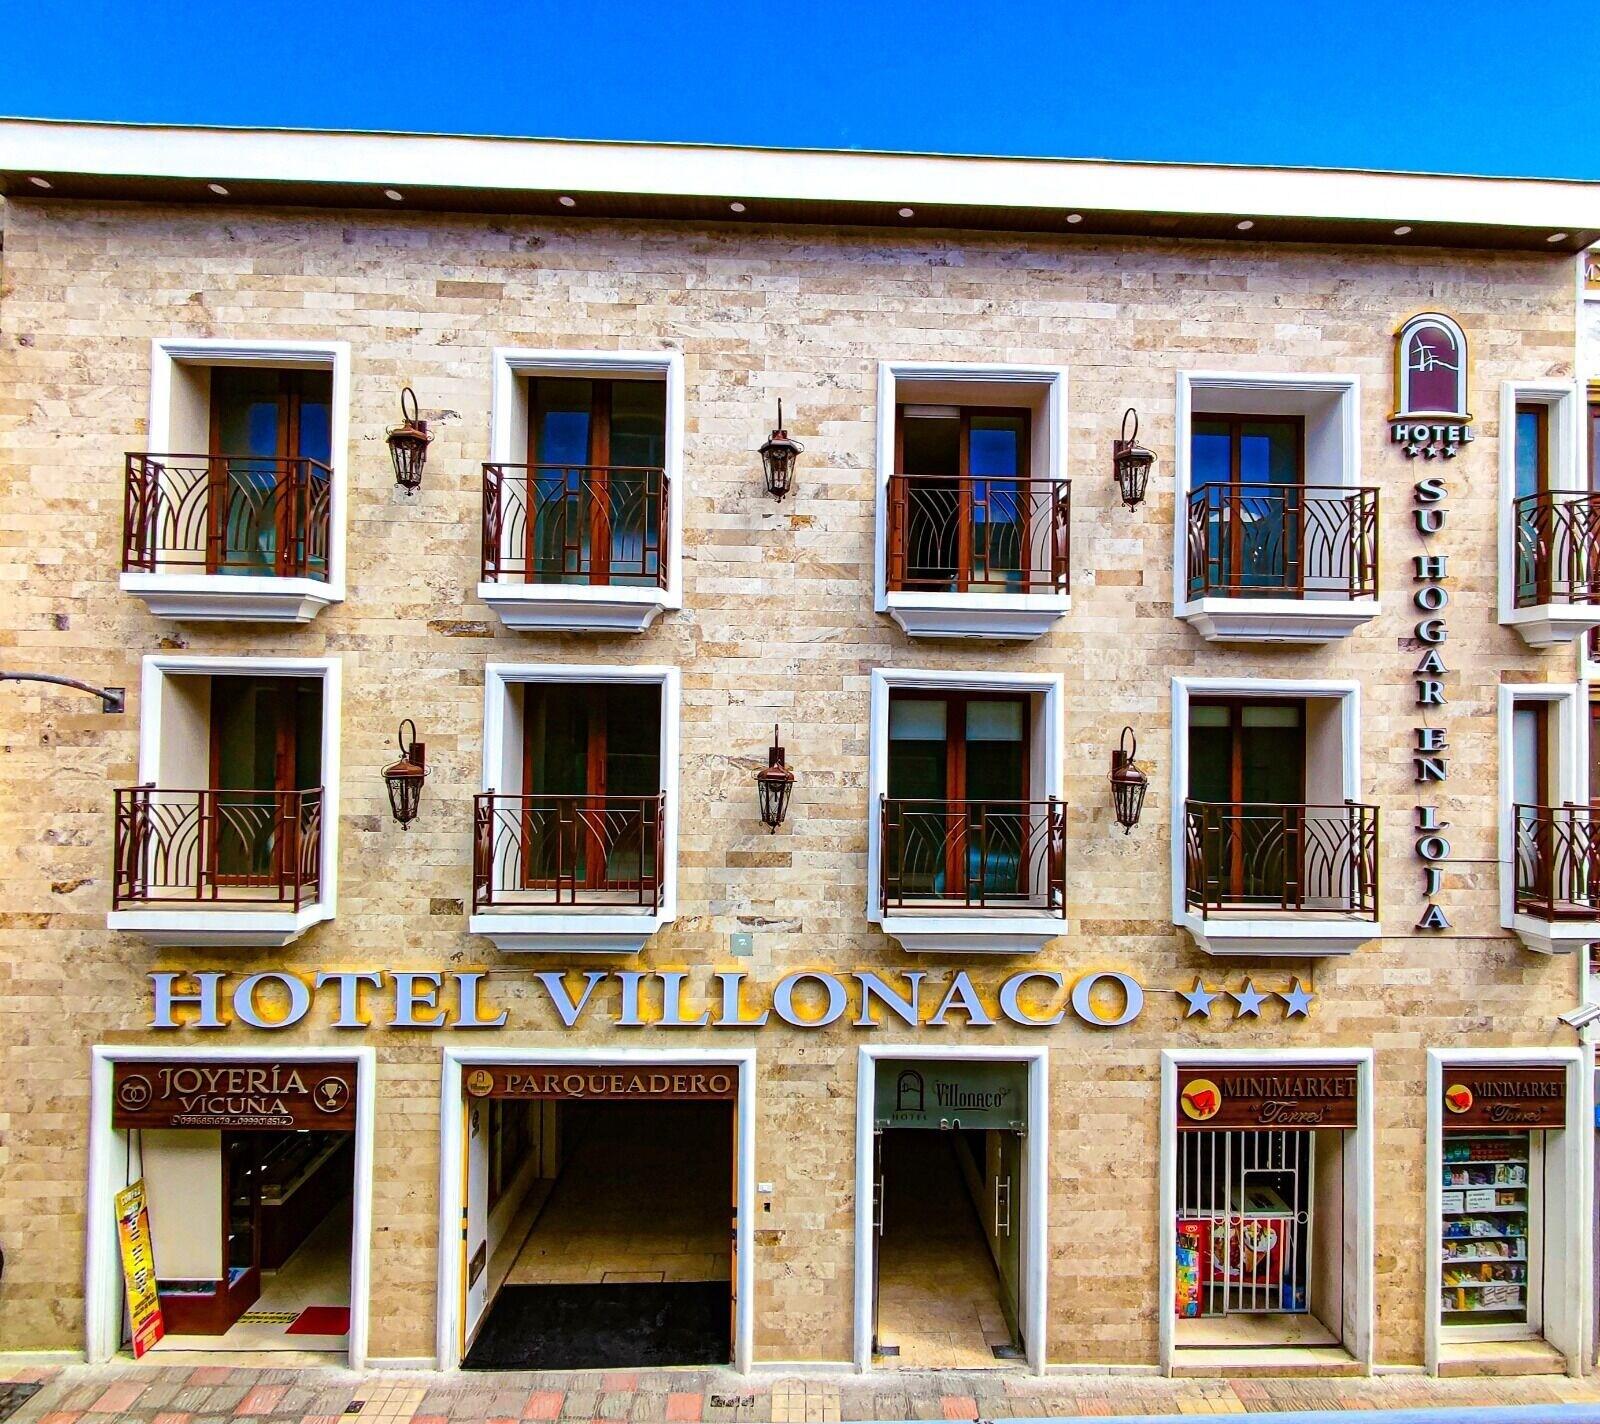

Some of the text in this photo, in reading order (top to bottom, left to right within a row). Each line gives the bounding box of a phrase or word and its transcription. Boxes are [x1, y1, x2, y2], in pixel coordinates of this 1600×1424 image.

[1392, 423, 1474, 442] HOTEL
[1413, 478, 1452, 929] SU HOGAR EN LOJA
[147, 971, 1145, 1028] HOTEL VILLONACO
[158, 1064, 309, 1099] JOYERÍA
[505, 1074, 731, 1098] PARQUEADERO
[1223, 1077, 1357, 1097] MINIMARKET
[1474, 1081, 1566, 1098] MINIMARKET
[180, 1095, 289, 1115] VICUÑA
[935, 1081, 1002, 1108] Villonaco
